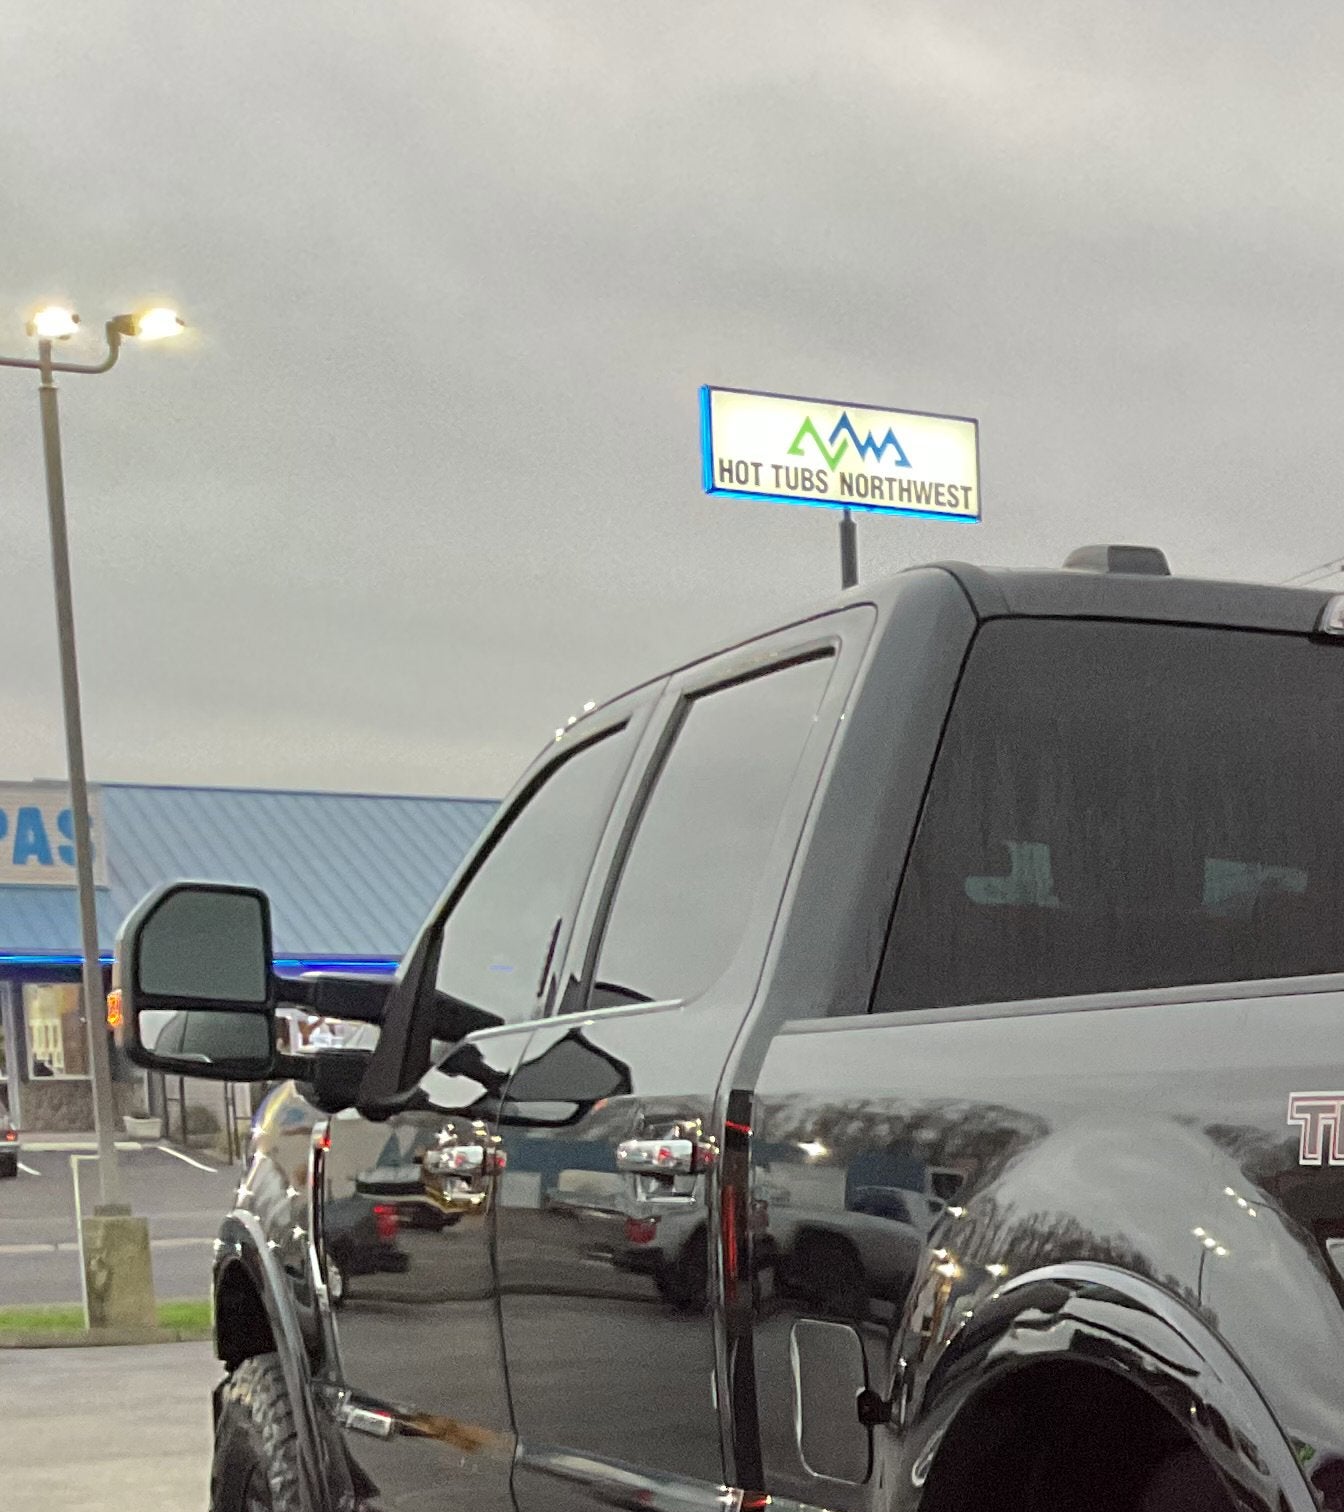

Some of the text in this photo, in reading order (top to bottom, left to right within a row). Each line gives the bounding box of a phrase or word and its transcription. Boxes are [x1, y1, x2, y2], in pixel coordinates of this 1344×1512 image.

[719, 458, 972, 510] HOT TUBS NORTHWEST
